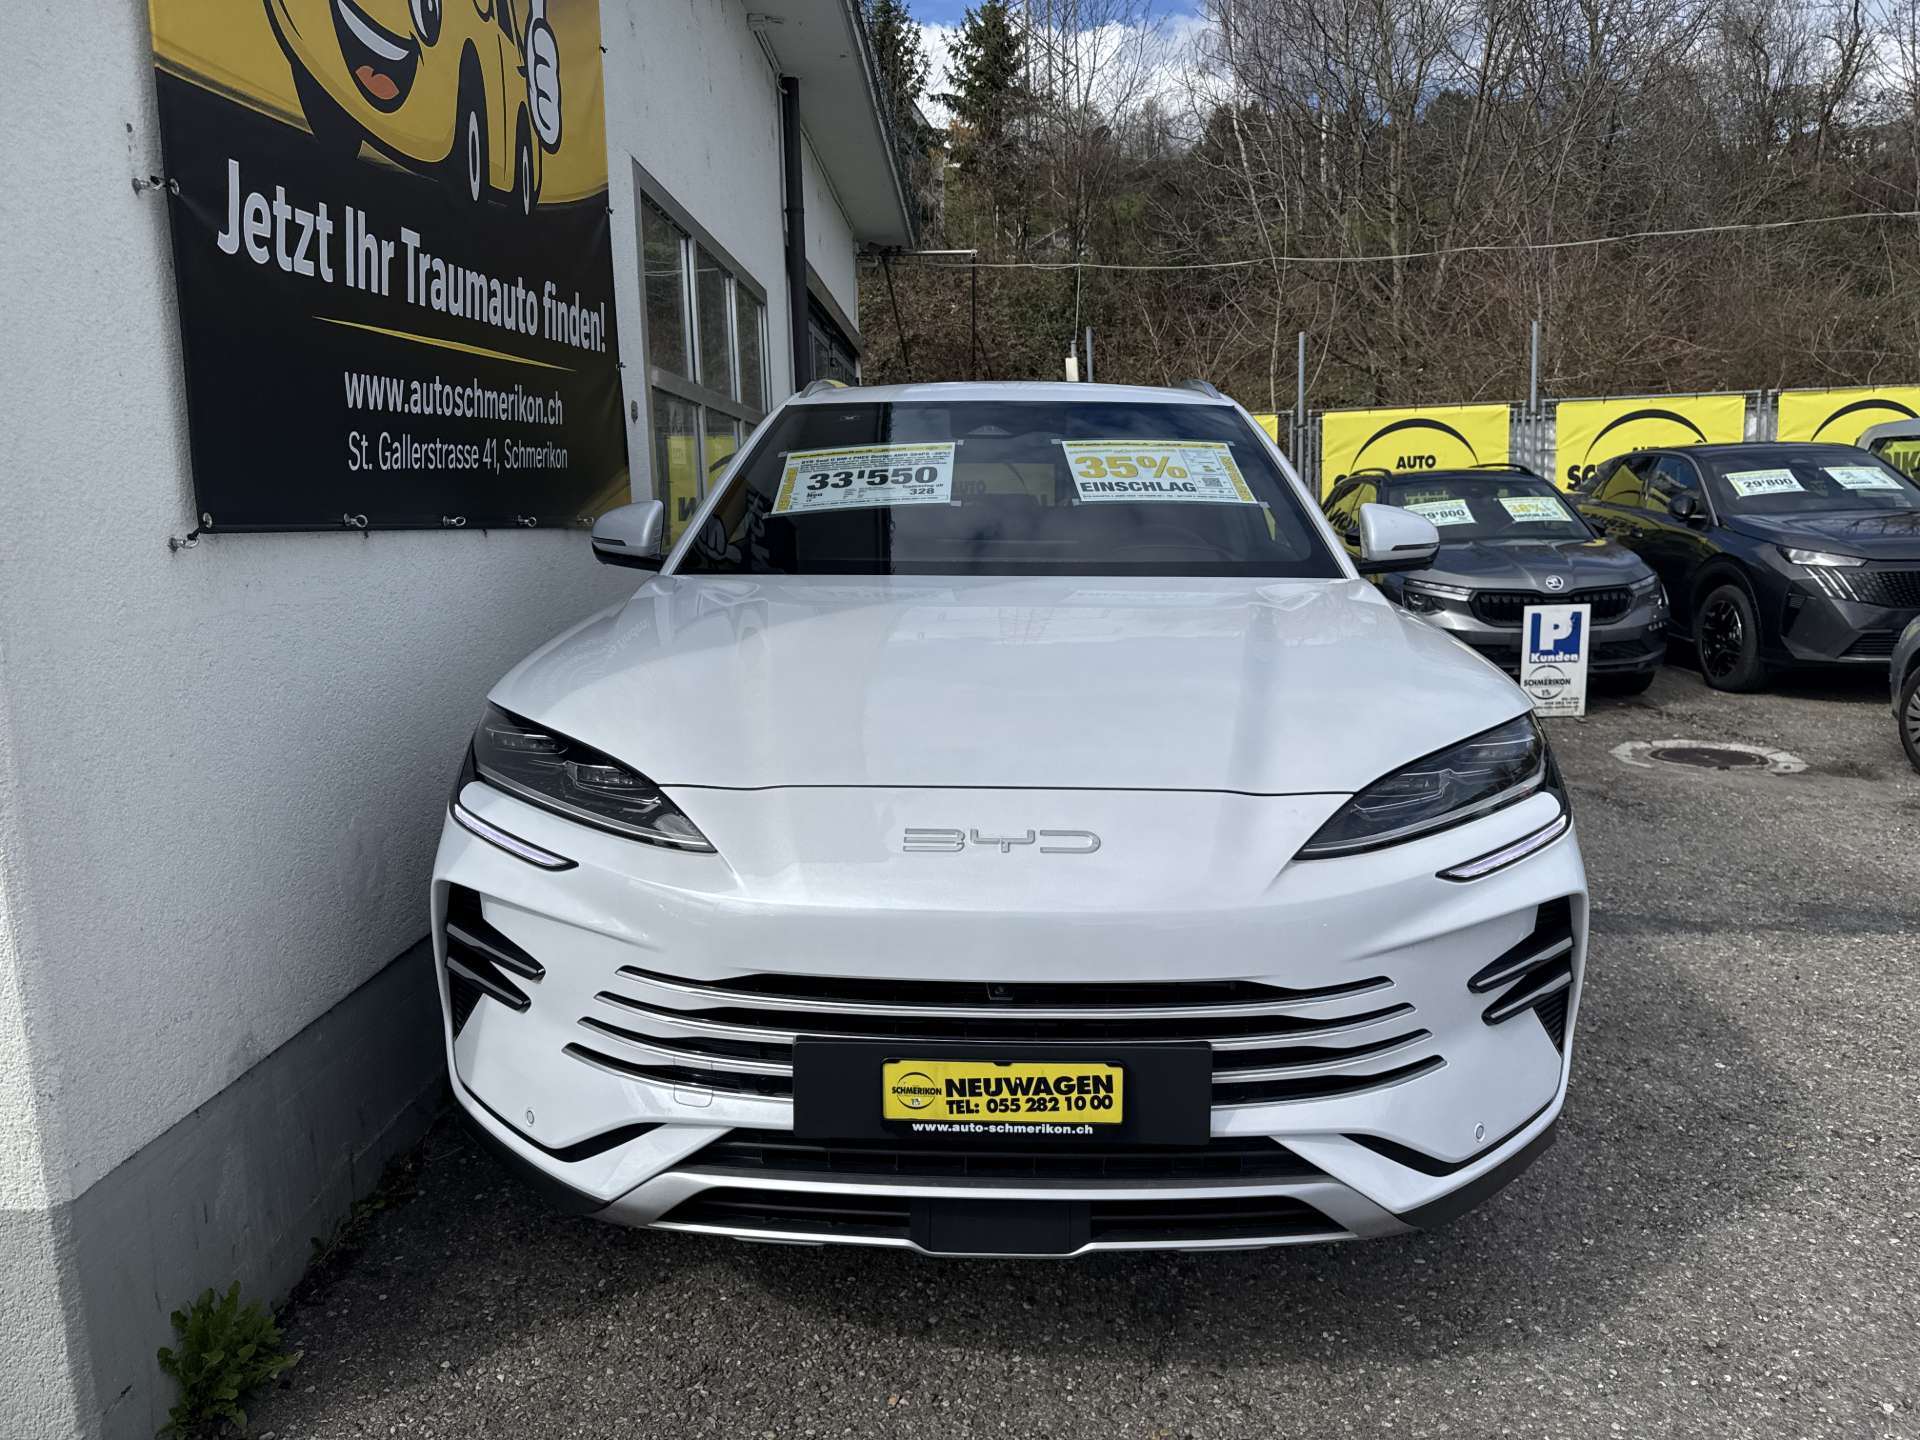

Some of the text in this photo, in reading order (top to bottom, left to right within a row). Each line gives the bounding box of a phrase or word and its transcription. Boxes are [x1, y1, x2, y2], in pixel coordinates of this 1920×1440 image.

[217, 158, 606, 352] Jetzt Ihr Traumauto finden!
[344, 371, 563, 425] www.autoschmerikon.ch
[348, 430, 568, 475] St. Gallerstrasse 41, Schmerikon
[1396, 455, 1436, 469] AUTO
[1074, 456, 1188, 479] 35%
[806, 466, 938, 491] 33'550
[1080, 481, 1197, 493] EINSCHLAG
[1743, 478, 1793, 488] 29'800
[1531, 651, 1579, 662] Kunden
[1524, 678, 1571, 687] SCHMERIKON
[903, 828, 1101, 854] BYD
[891, 1086, 942, 1096] SCHMERIKON
[945, 1074, 1114, 1098] NEUWAGEN
[946, 1094, 1113, 1114] TEL: 055 282 10 00
[912, 1121, 1094, 1135] www.auto-schmerikon.ch
